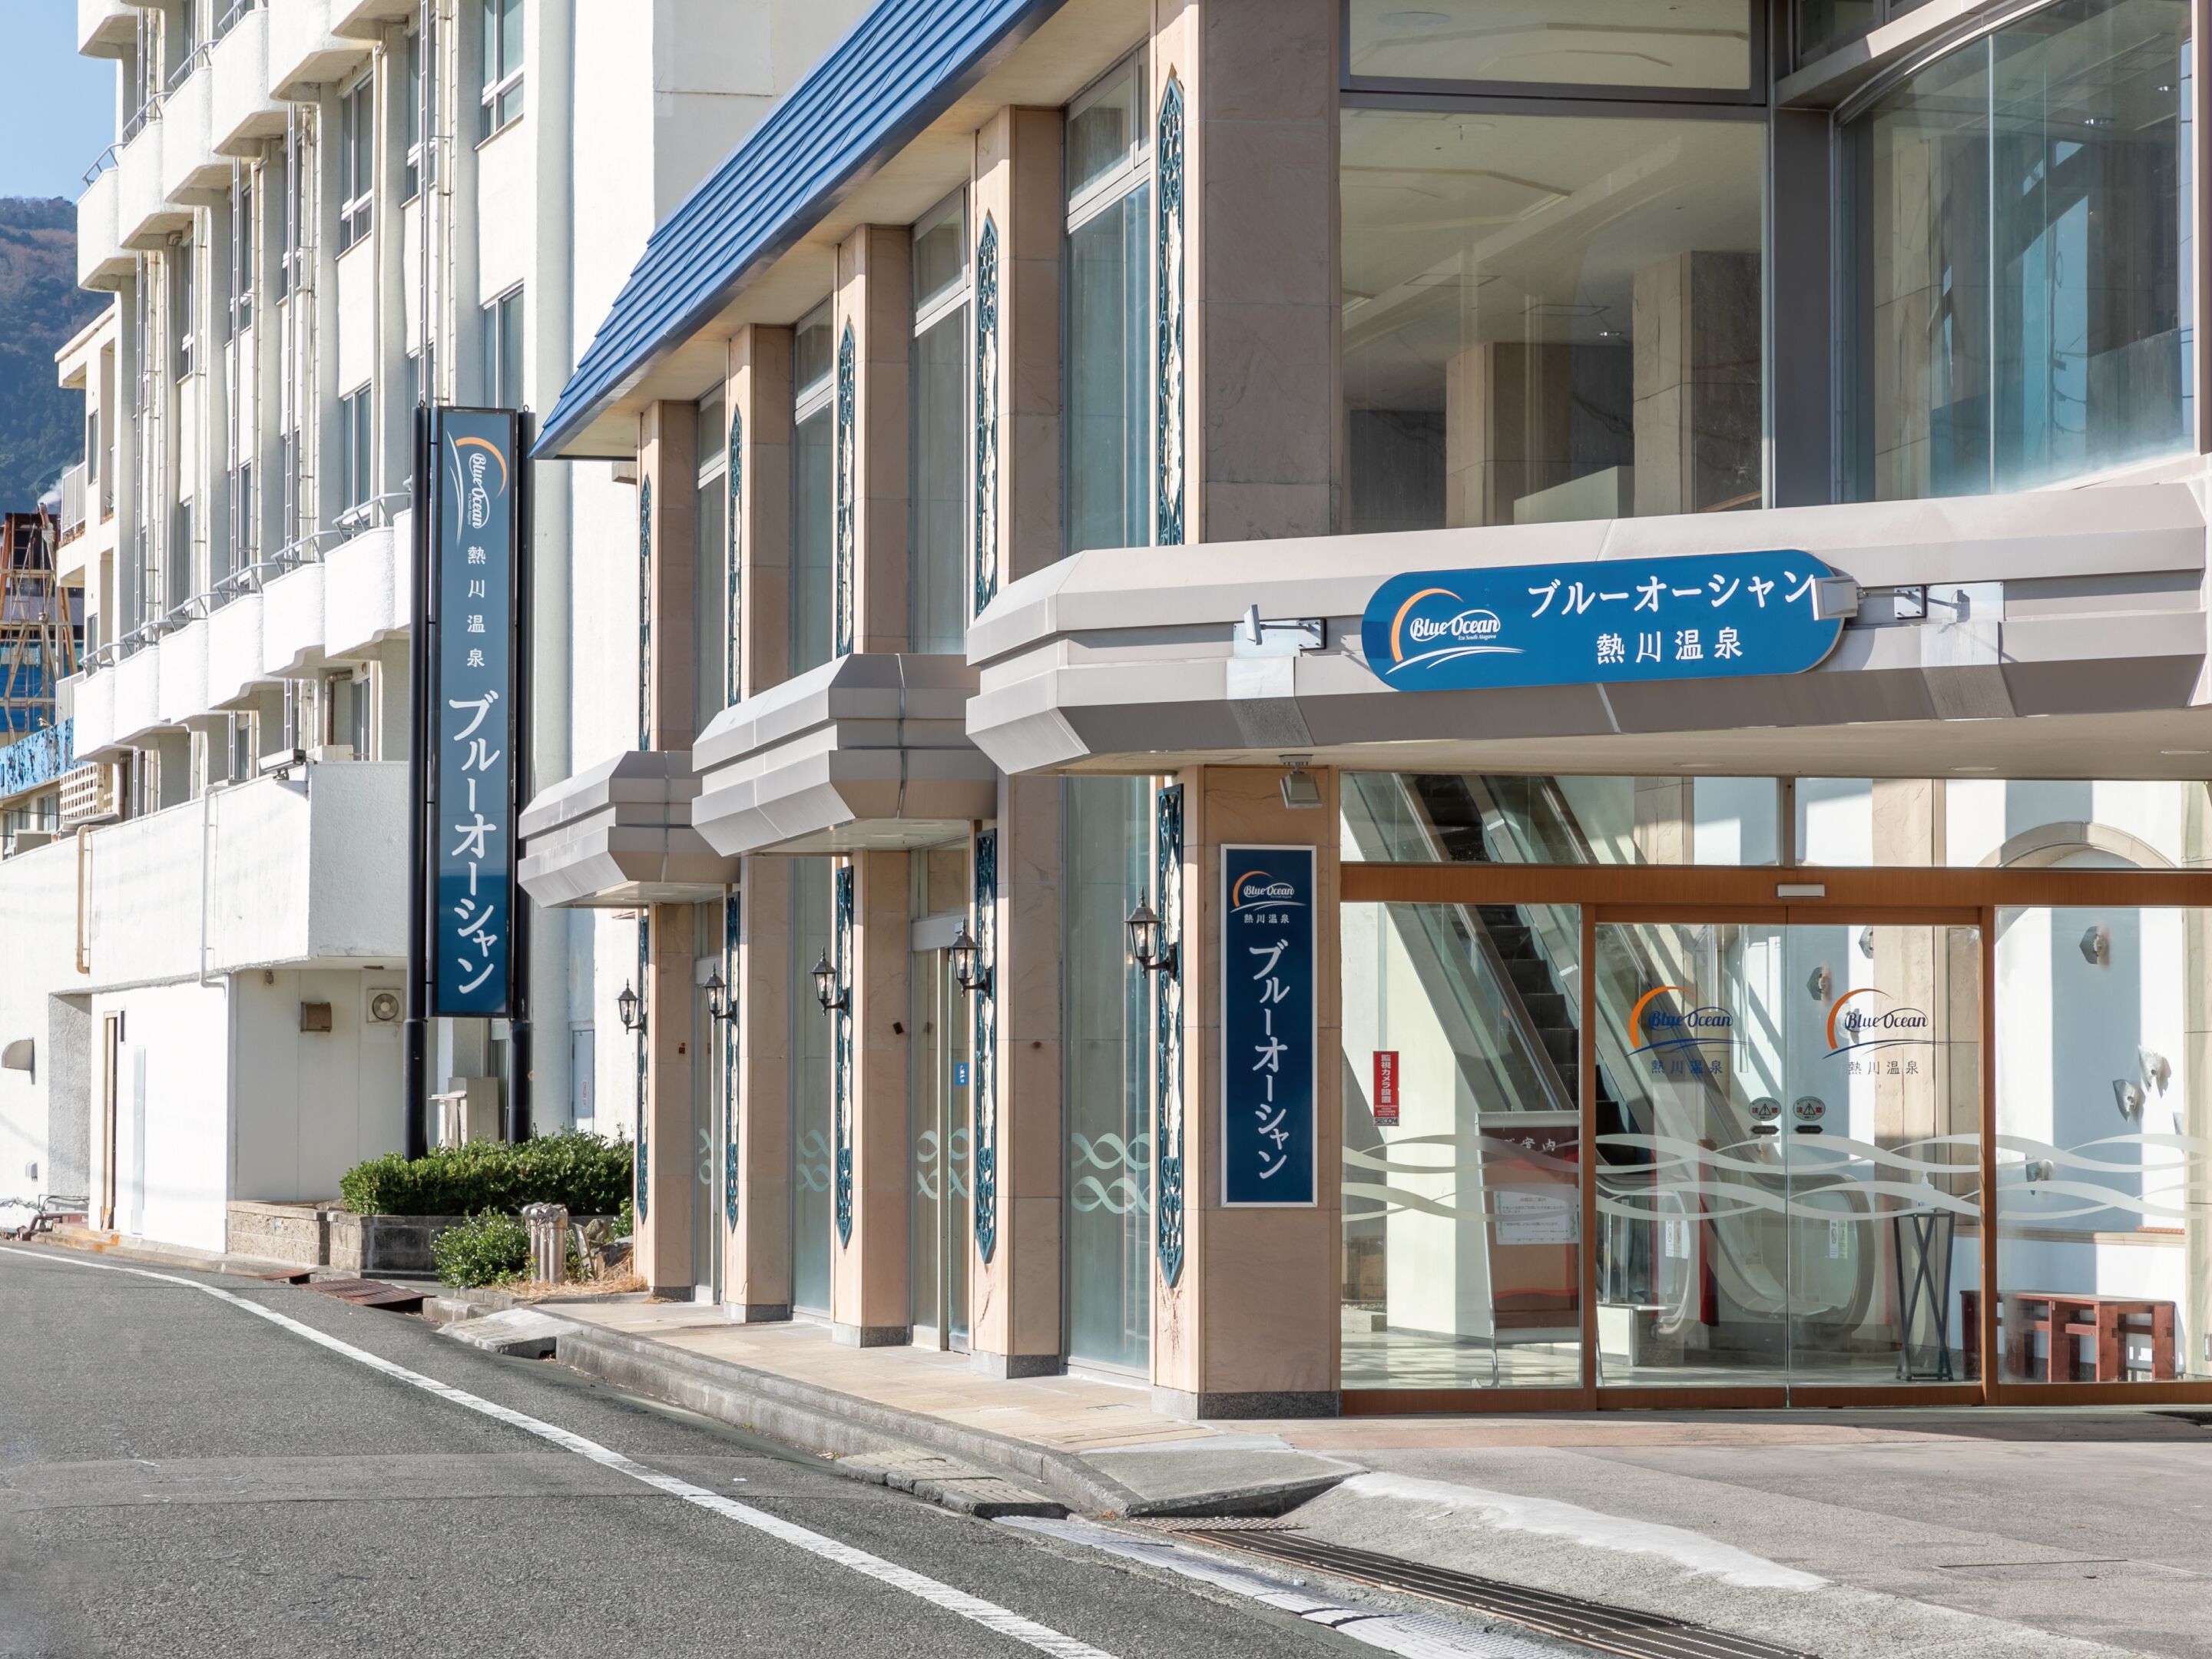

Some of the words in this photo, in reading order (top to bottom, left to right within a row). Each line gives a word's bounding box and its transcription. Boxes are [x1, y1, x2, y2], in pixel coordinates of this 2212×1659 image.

[469, 453, 486, 484] Blue
[472, 487, 489, 528] Ocean
[467, 546, 485, 667] 熱川温泉
[1528, 571, 1814, 618] ブルーオーシャン
[1410, 618, 1447, 641] Blue
[1449, 609, 1501, 636] Ocean
[1597, 626, 1743, 664] 熱川温泉
[449, 690, 501, 994] ブルーオーシャン
[1243, 885, 1265, 898] Blue
[1266, 882, 1295, 896] Ocean
[1244, 914, 1290, 924] 熱川温泉
[1647, 1011, 1684, 1031] Blue
[1687, 1007, 1734, 1028] Ocean
[1845, 1012, 1879, 1032] Blue
[1883, 1008, 1929, 1028] Ocean
[1249, 939, 1290, 1179] ブルーオーシャン
[1651, 1060, 1723, 1075] 熱川温泉
[1848, 1061, 1919, 1075] 熱川温泉
